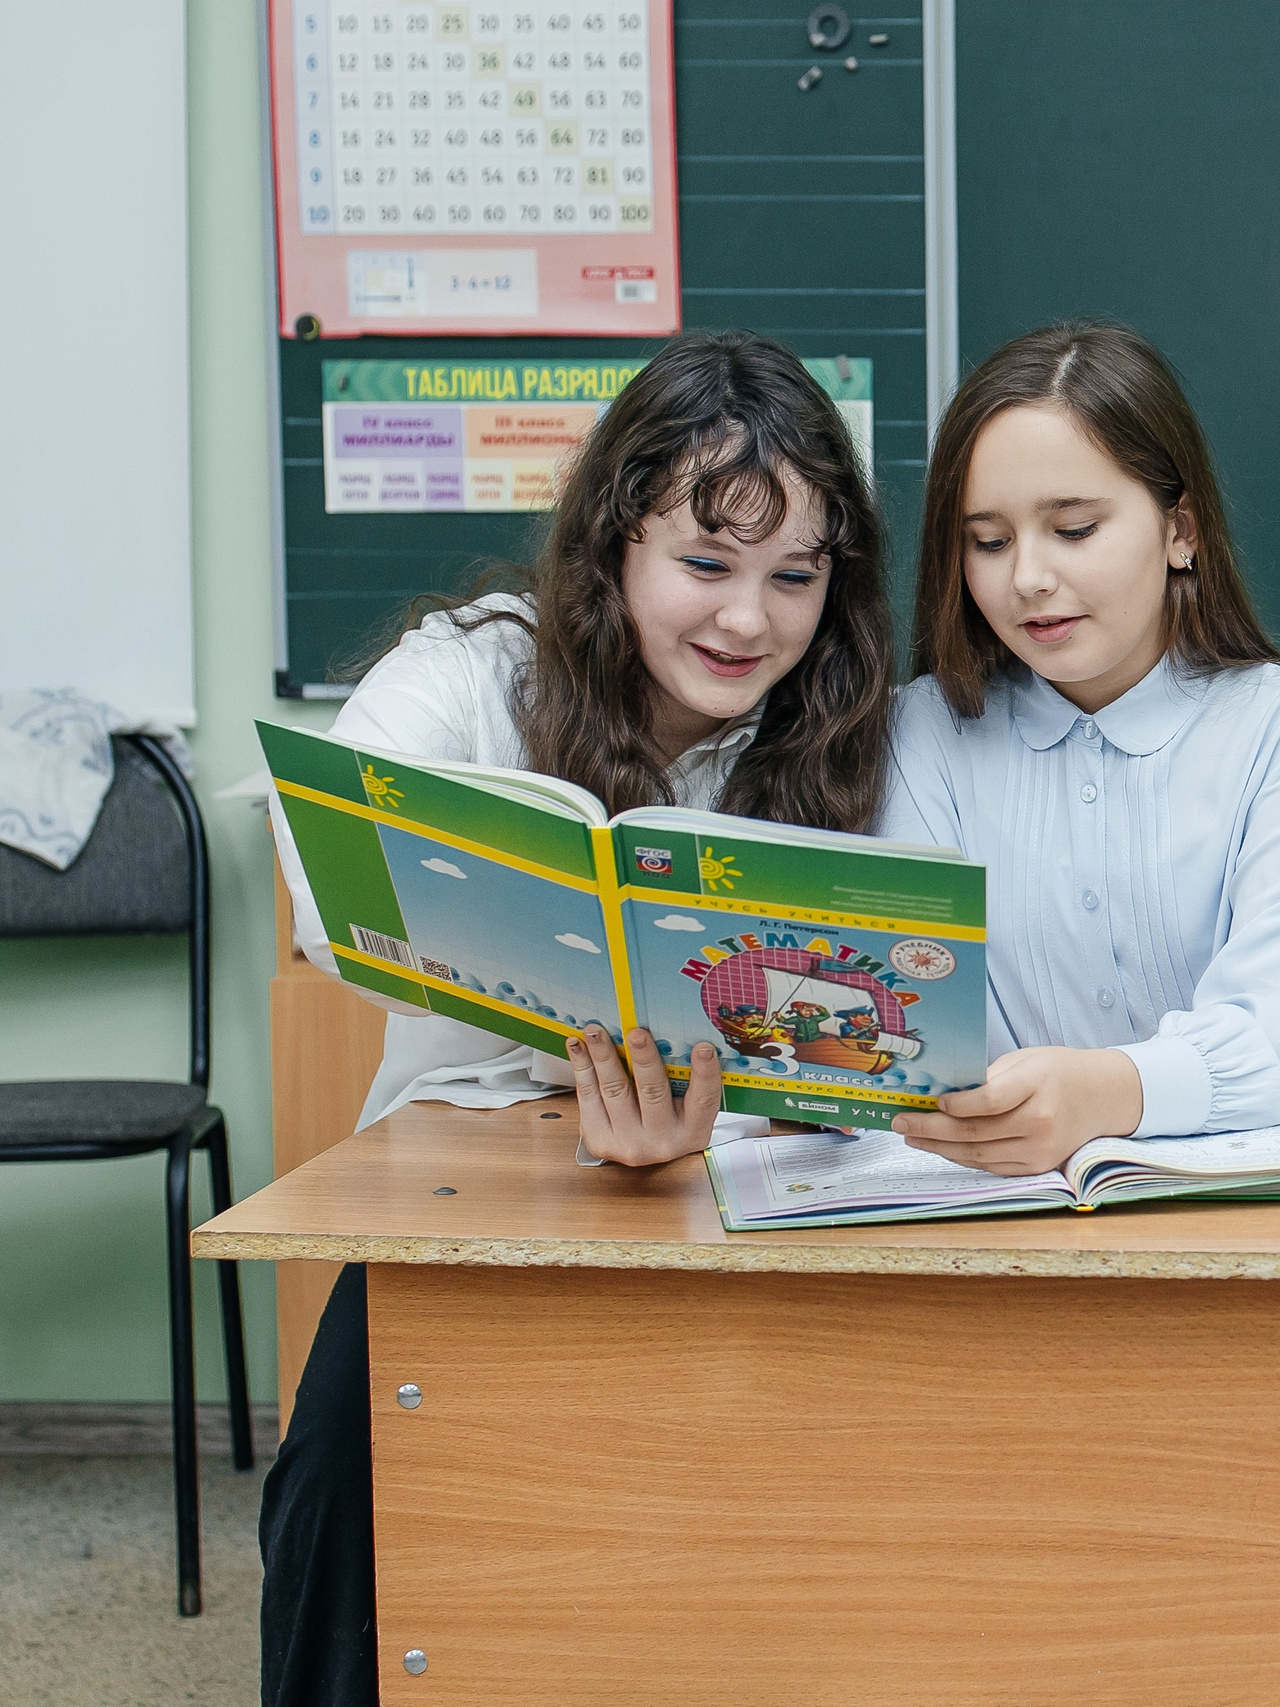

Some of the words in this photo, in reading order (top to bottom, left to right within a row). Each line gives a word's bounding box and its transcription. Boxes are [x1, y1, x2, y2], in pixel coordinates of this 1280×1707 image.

[337, 15, 358, 32] 10
[373, 15, 394, 32] 15
[407, 14, 428, 31] 20
[442, 14, 463, 31] 25
[549, 14, 570, 31] 40
[584, 14, 605, 31] 45
[620, 14, 641, 31] 50
[339, 54, 360, 71] 12
[373, 54, 394, 71] 18
[408, 54, 429, 71] 24
[513, 53, 534, 70] 42
[549, 53, 570, 70] 48
[584, 53, 605, 70] 54
[620, 53, 641, 70] 60
[340, 92, 361, 109] 14
[374, 92, 395, 109] 21
[409, 91, 430, 108] 28
[479, 91, 500, 108] 42
[515, 91, 536, 108] 49
[551, 91, 572, 108] 56
[622, 91, 643, 108] 70
[341, 130, 362, 147] 16
[375, 130, 396, 147] 24
[446, 130, 467, 147] 40
[481, 130, 502, 147] 48
[516, 129, 537, 146] 56
[551, 129, 572, 146] 64
[587, 129, 608, 146] 72
[623, 129, 644, 146] 80
[343, 168, 364, 185] 18
[376, 168, 397, 185] 27
[447, 168, 468, 185] 45
[482, 167, 503, 184] 54
[553, 167, 574, 184] 72
[588, 167, 609, 184] 81
[623, 167, 644, 184] 90
[309, 206, 330, 223] 10
[344, 206, 365, 223] 20
[414, 205, 435, 222] 40
[449, 205, 470, 222] 50
[484, 205, 505, 222] 60
[519, 205, 540, 222] 70
[555, 205, 576, 222] 80
[590, 204, 611, 221] 90
[621, 204, 649, 221] 100
[406, 368, 518, 399] ТАБЛИЦА
[523, 368, 643, 399] РАЗРЯДО
[636, 848, 669, 858] ФГОС
[694, 899, 768, 914] УЧУСЬ
[788, 910, 896, 930] УЧИТЬСЯ
[784, 922, 840, 937] Петерсон
[680, 932, 921, 1007] МАТЕМАТИКА
[758, 1041, 800, 1077] 3
[803, 1071, 874, 1088] класс
[795, 1083, 834, 1094] КУРС
[844, 1089, 939, 1107] МАТЕМАТИК
[801, 1102, 837, 1112] БИНОМ
[851, 1107, 892, 1120] УЧЕ
